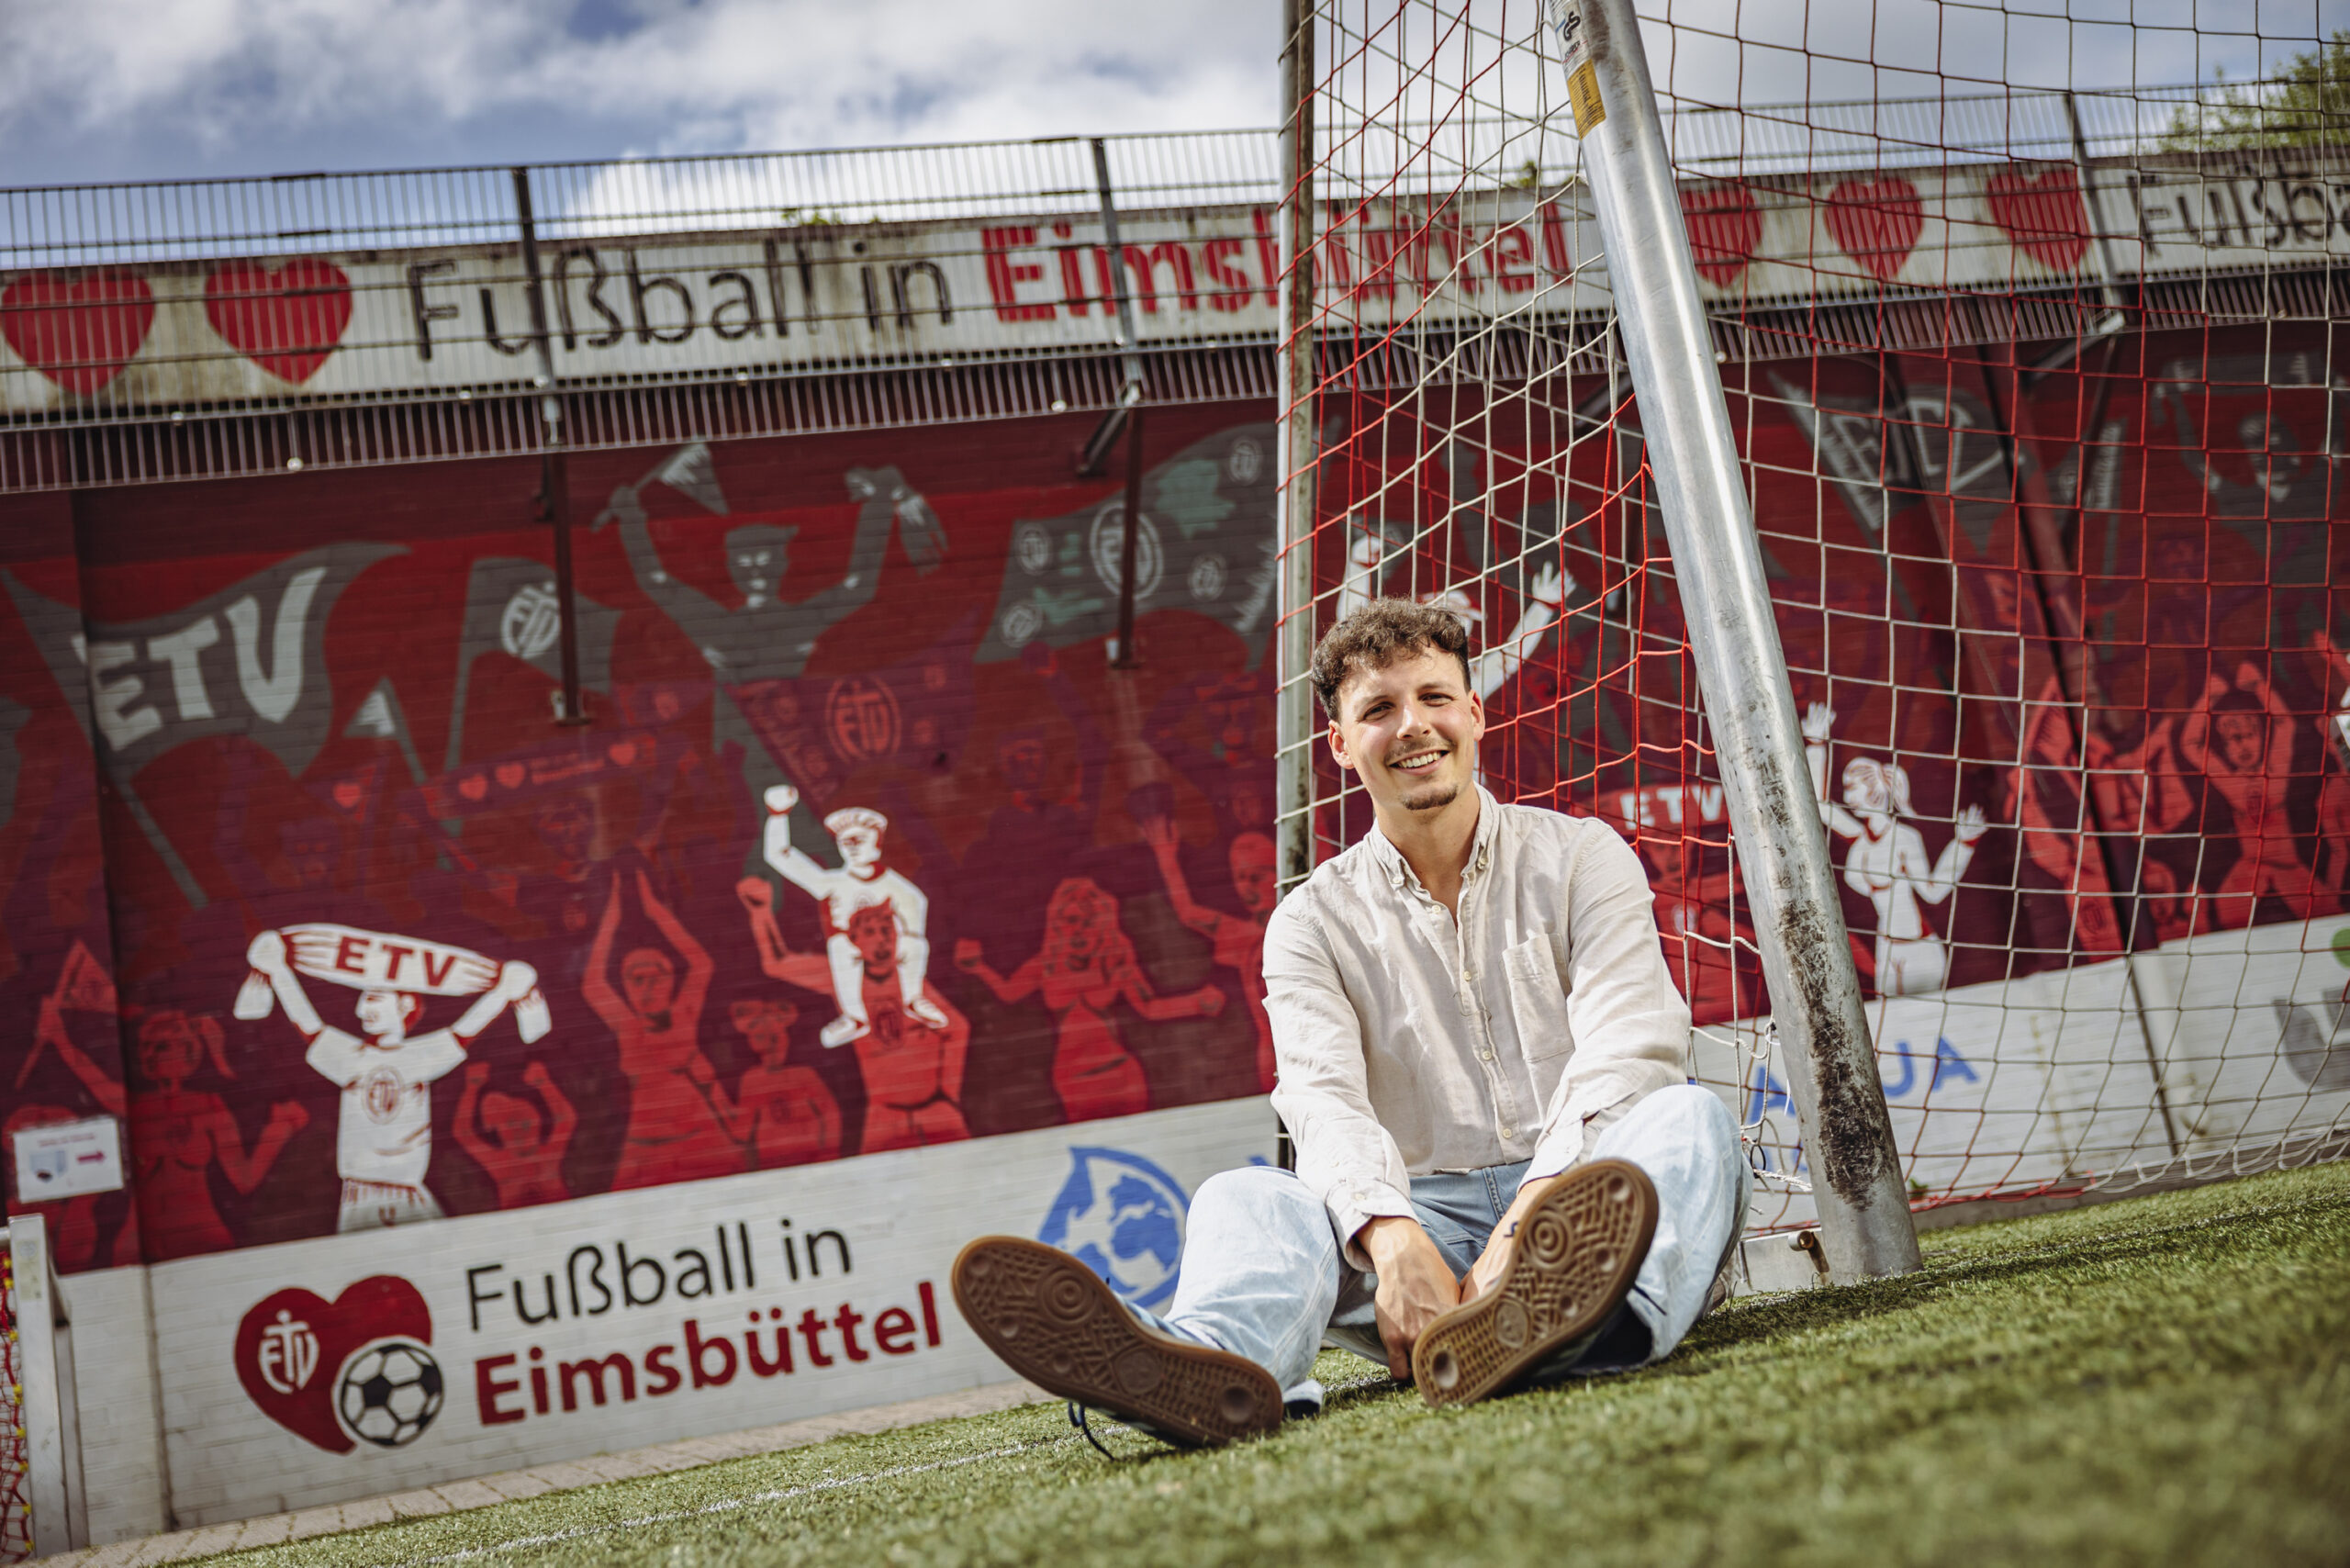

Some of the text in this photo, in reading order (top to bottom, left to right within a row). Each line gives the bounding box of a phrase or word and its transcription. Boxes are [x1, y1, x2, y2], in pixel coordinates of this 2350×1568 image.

[408, 237, 820, 361] Fußball
[852, 241, 953, 332] in
[72, 567, 328, 752] ETV
[1619, 784, 1724, 831] ETV
[335, 936, 456, 988] ETV
[466, 1217, 851, 1332] Fußball in
[475, 1280, 942, 1428] Eimsbüttel
